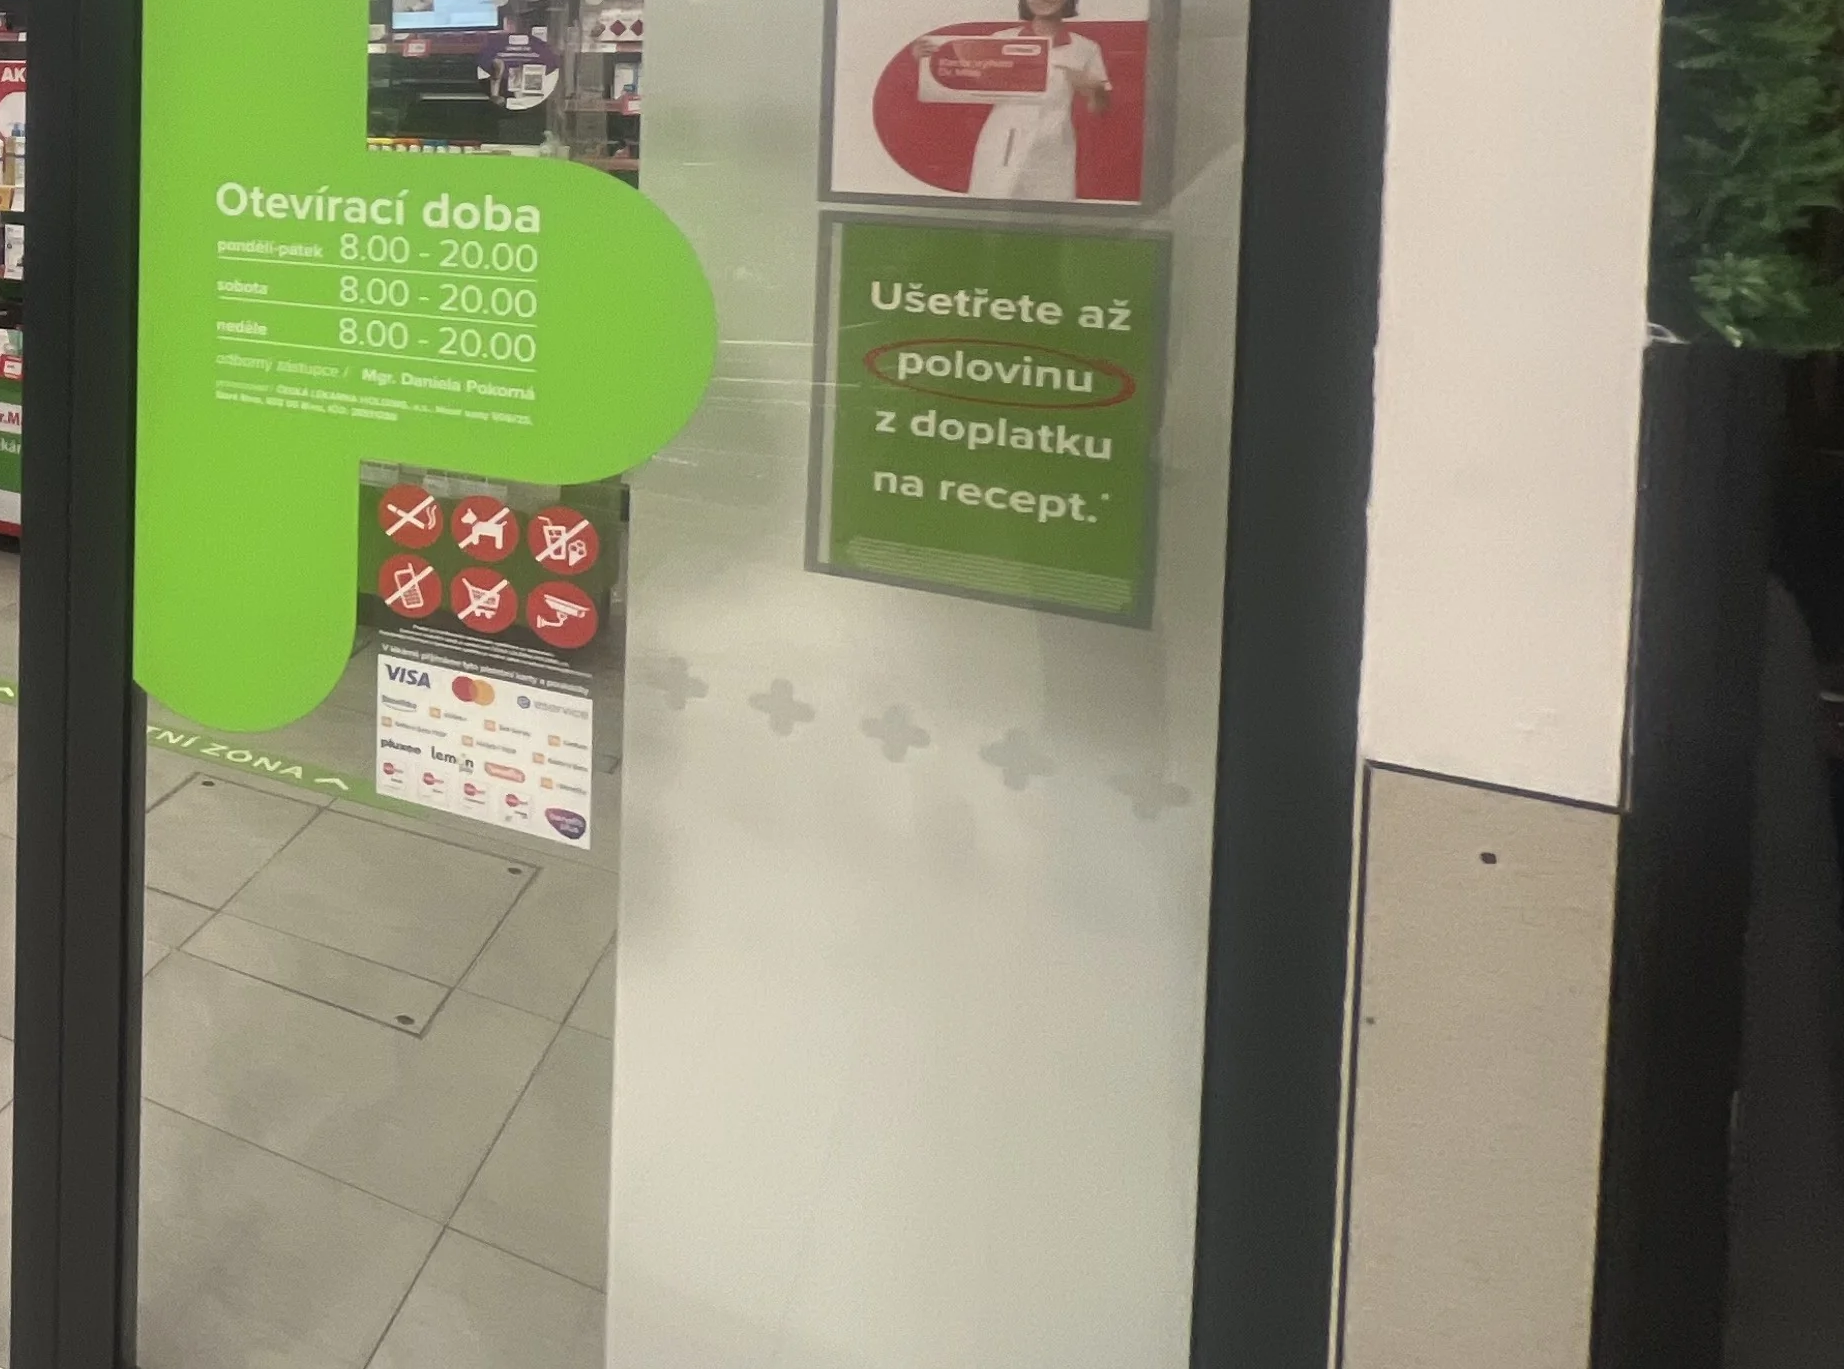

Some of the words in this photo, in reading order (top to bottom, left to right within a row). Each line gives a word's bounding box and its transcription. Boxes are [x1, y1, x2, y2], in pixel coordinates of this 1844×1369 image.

[215, 181, 406, 226] Otevírací
[422, 194, 542, 235] doba
[339, 232, 410, 264] 8.00
[439, 238, 539, 274] 20.00
[216, 279, 269, 295] sobota
[339, 275, 410, 307] 8.00
[439, 283, 539, 318] 20.00
[870, 280, 1064, 326] Ušetřete
[1077, 299, 1132, 331] až
[216, 319, 269, 336] neděle
[338, 317, 410, 350] 8.00
[438, 326, 538, 363] 20.00
[361, 367, 398, 387] Mgr.
[400, 372, 462, 392] Daniela
[897, 350, 1094, 393] polovinu
[874, 410, 897, 433] z
[909, 409, 1113, 461] doplatku
[873, 470, 924, 499] na
[385, 662, 432, 690] VISA
